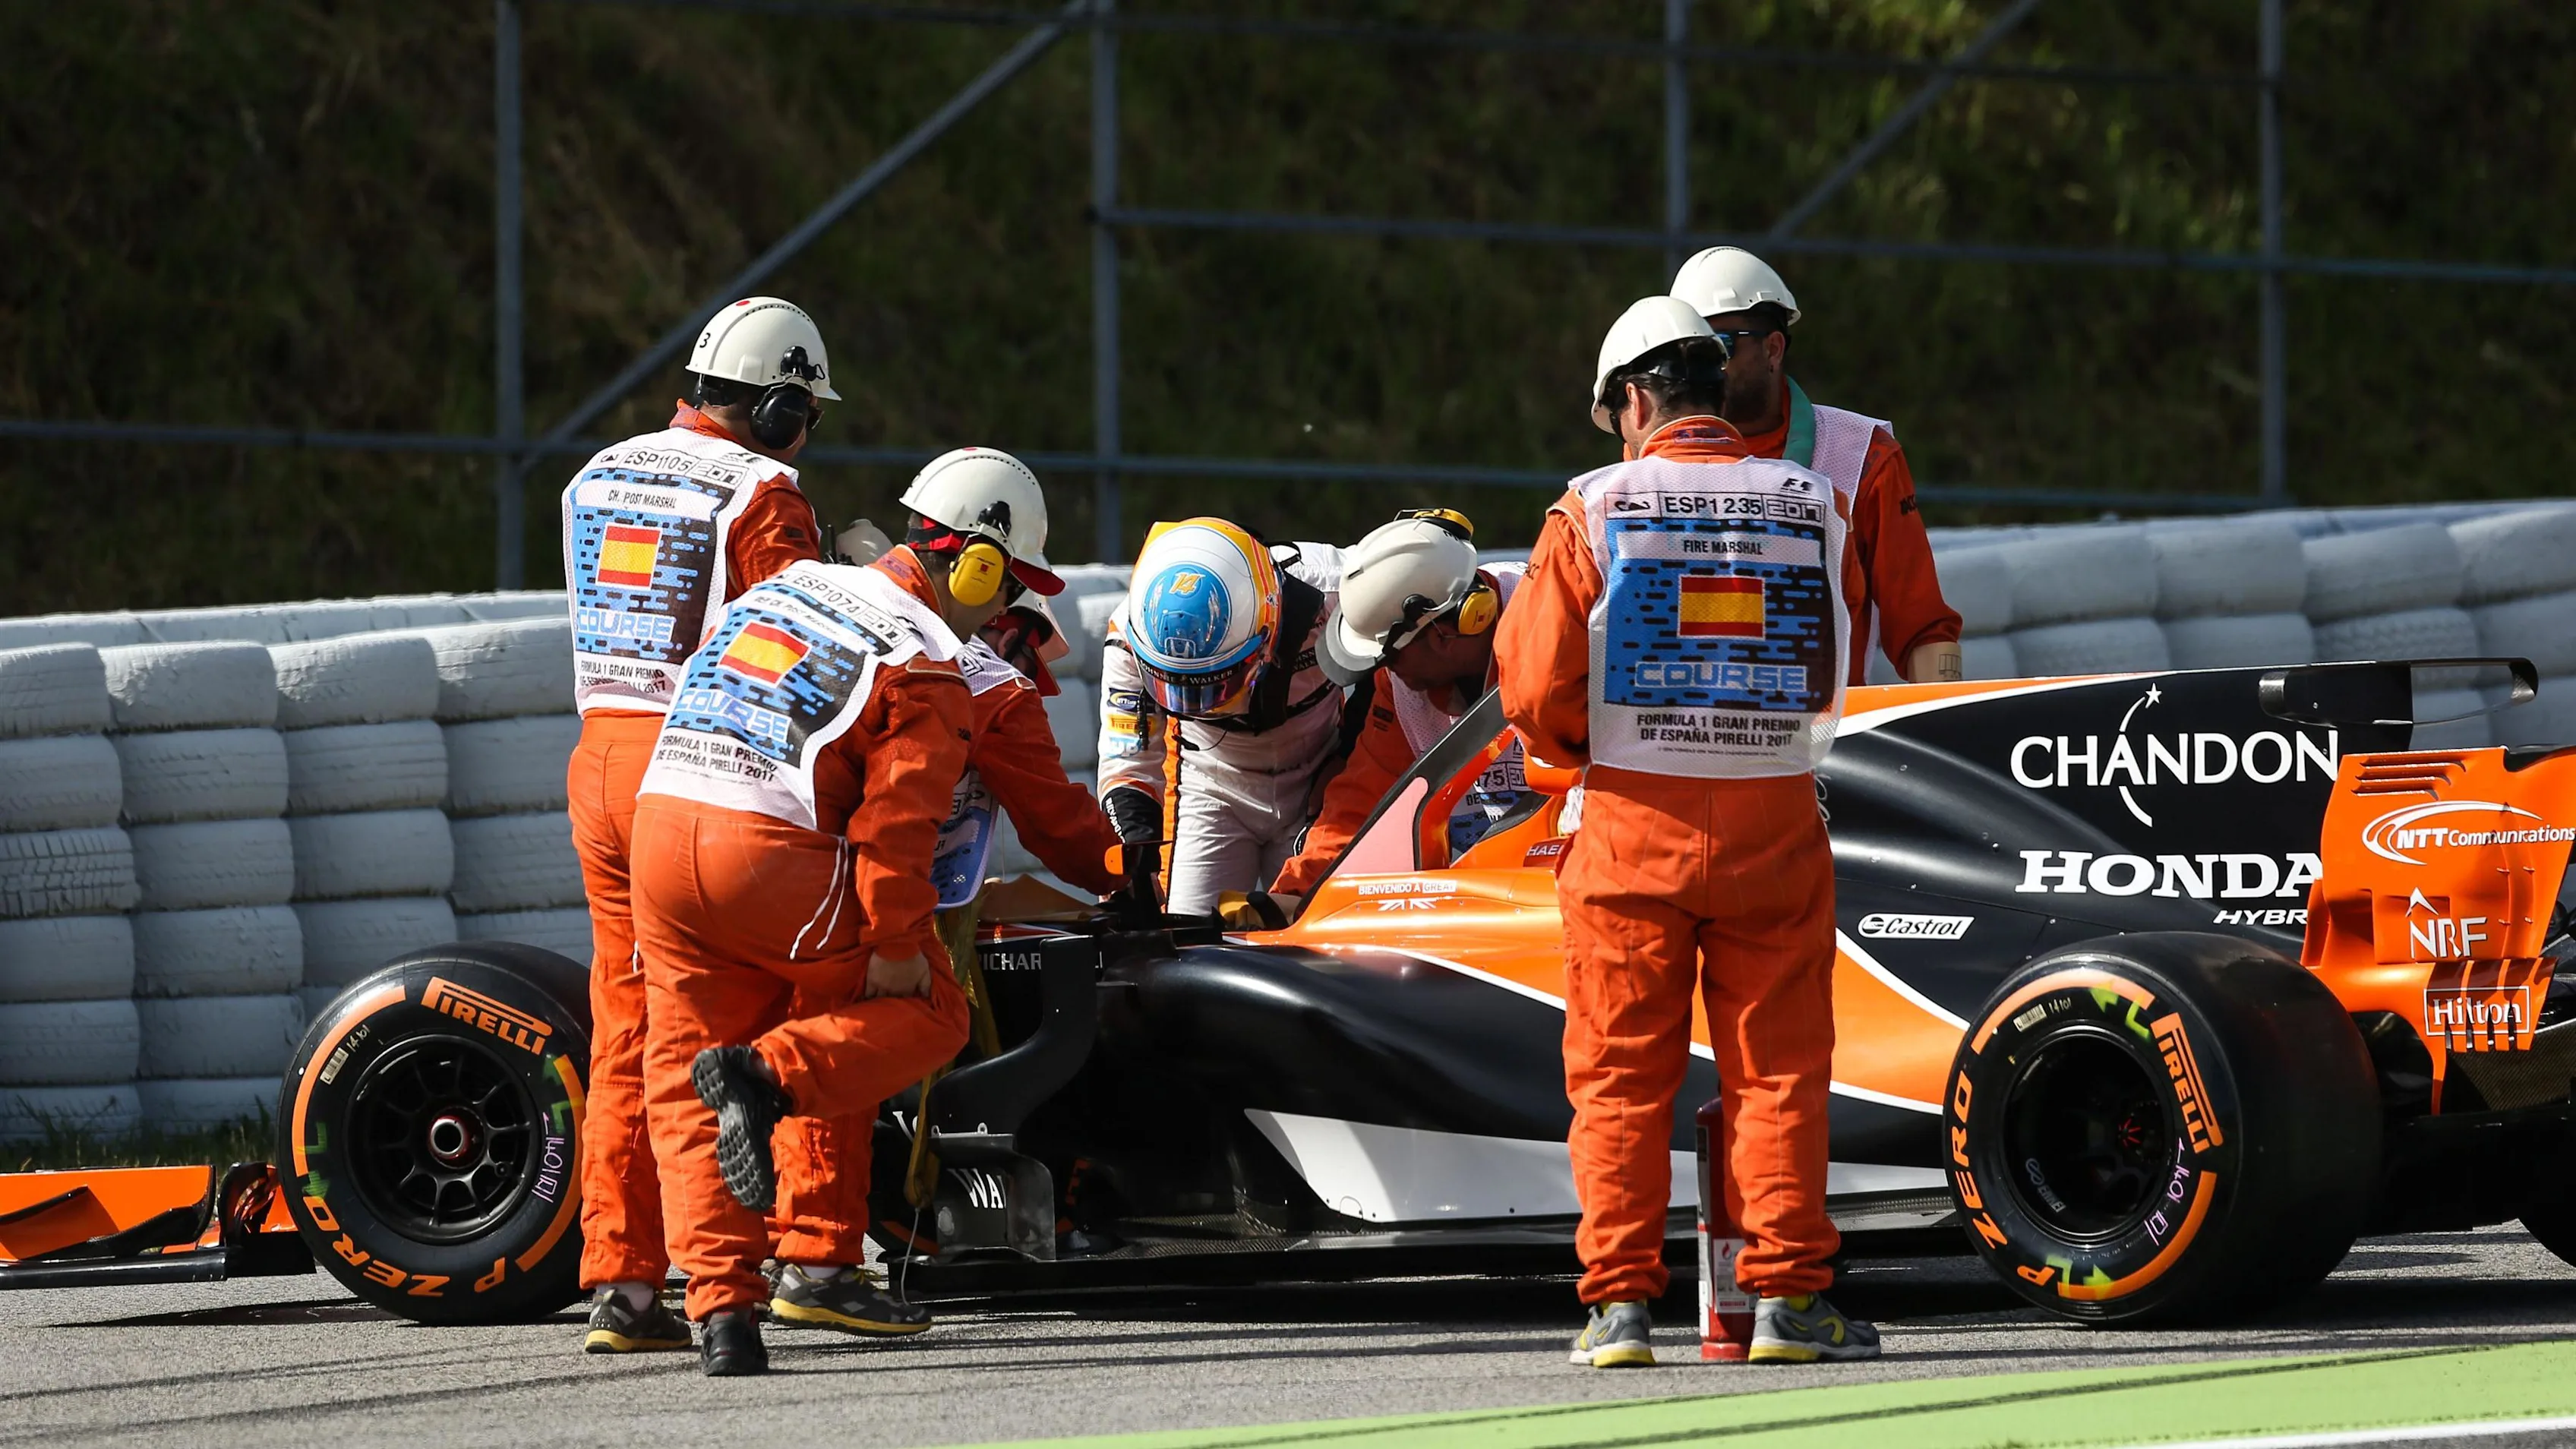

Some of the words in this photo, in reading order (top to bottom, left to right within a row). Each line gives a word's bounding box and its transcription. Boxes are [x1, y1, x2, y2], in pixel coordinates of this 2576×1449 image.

[623, 451, 690, 475] ESP1105
[623, 491, 642, 504] POST
[644, 493, 677, 509] MARSHAL
[1766, 499, 1822, 522] 2017
[1683, 540, 1709, 553] FIRE
[1711, 541, 1763, 555] MARSHAL
[792, 575, 861, 614] ESP1074
[1170, 572, 1202, 595] 14
[576, 607, 677, 643] COURSE
[603, 664, 608, 674] 1
[609, 664, 634, 677] GRAN
[635, 667, 665, 680] PREMIO
[1189, 669, 1233, 684] WALKER
[1635, 661, 1808, 693] COURSE
[644, 680, 667, 694] 2017
[674, 688, 792, 744] COURSE
[1637, 714, 1697, 728] FORMULA
[1702, 716, 1707, 728] 1
[1712, 715, 1749, 730] GRAN
[1752, 717, 1801, 732] PREMIO
[1640, 728, 1656, 740] DE
[1660, 728, 1710, 744] ESPAÑA
[1714, 732, 1762, 746] PIRELLI
[1766, 733, 1794, 747] 2017
[661, 734, 700, 750] FORMULA
[703, 741, 708, 753] 1
[711, 742, 733, 757] GRAN
[735, 747, 778, 772] PREMIO
[666, 749, 706, 769] ESPAÑA
[709, 758, 743, 774] PIRELLI
[744, 765, 775, 782] 2017
[2010, 730, 2338, 788] CHANDON
[2396, 827, 2448, 849] NTT
[2448, 824, 2575, 847] Communications
[1358, 884, 1413, 895] BIENVENIDO
[1414, 882, 1421, 892] A
[2015, 850, 2323, 898] HONDA
[1885, 917, 1962, 936] Castrol
[2409, 917, 2487, 959] NRF
[421, 976, 554, 1056] PIRELLI
[2432, 996, 2522, 1025] Hilton
[2150, 1012, 2224, 1154] PIRELLI
[1951, 1069, 2008, 1251] ZERO
[302, 1195, 451, 1298] ZERO
[474, 1257, 506, 1294] P
[2016, 1265, 2056, 1287] P
